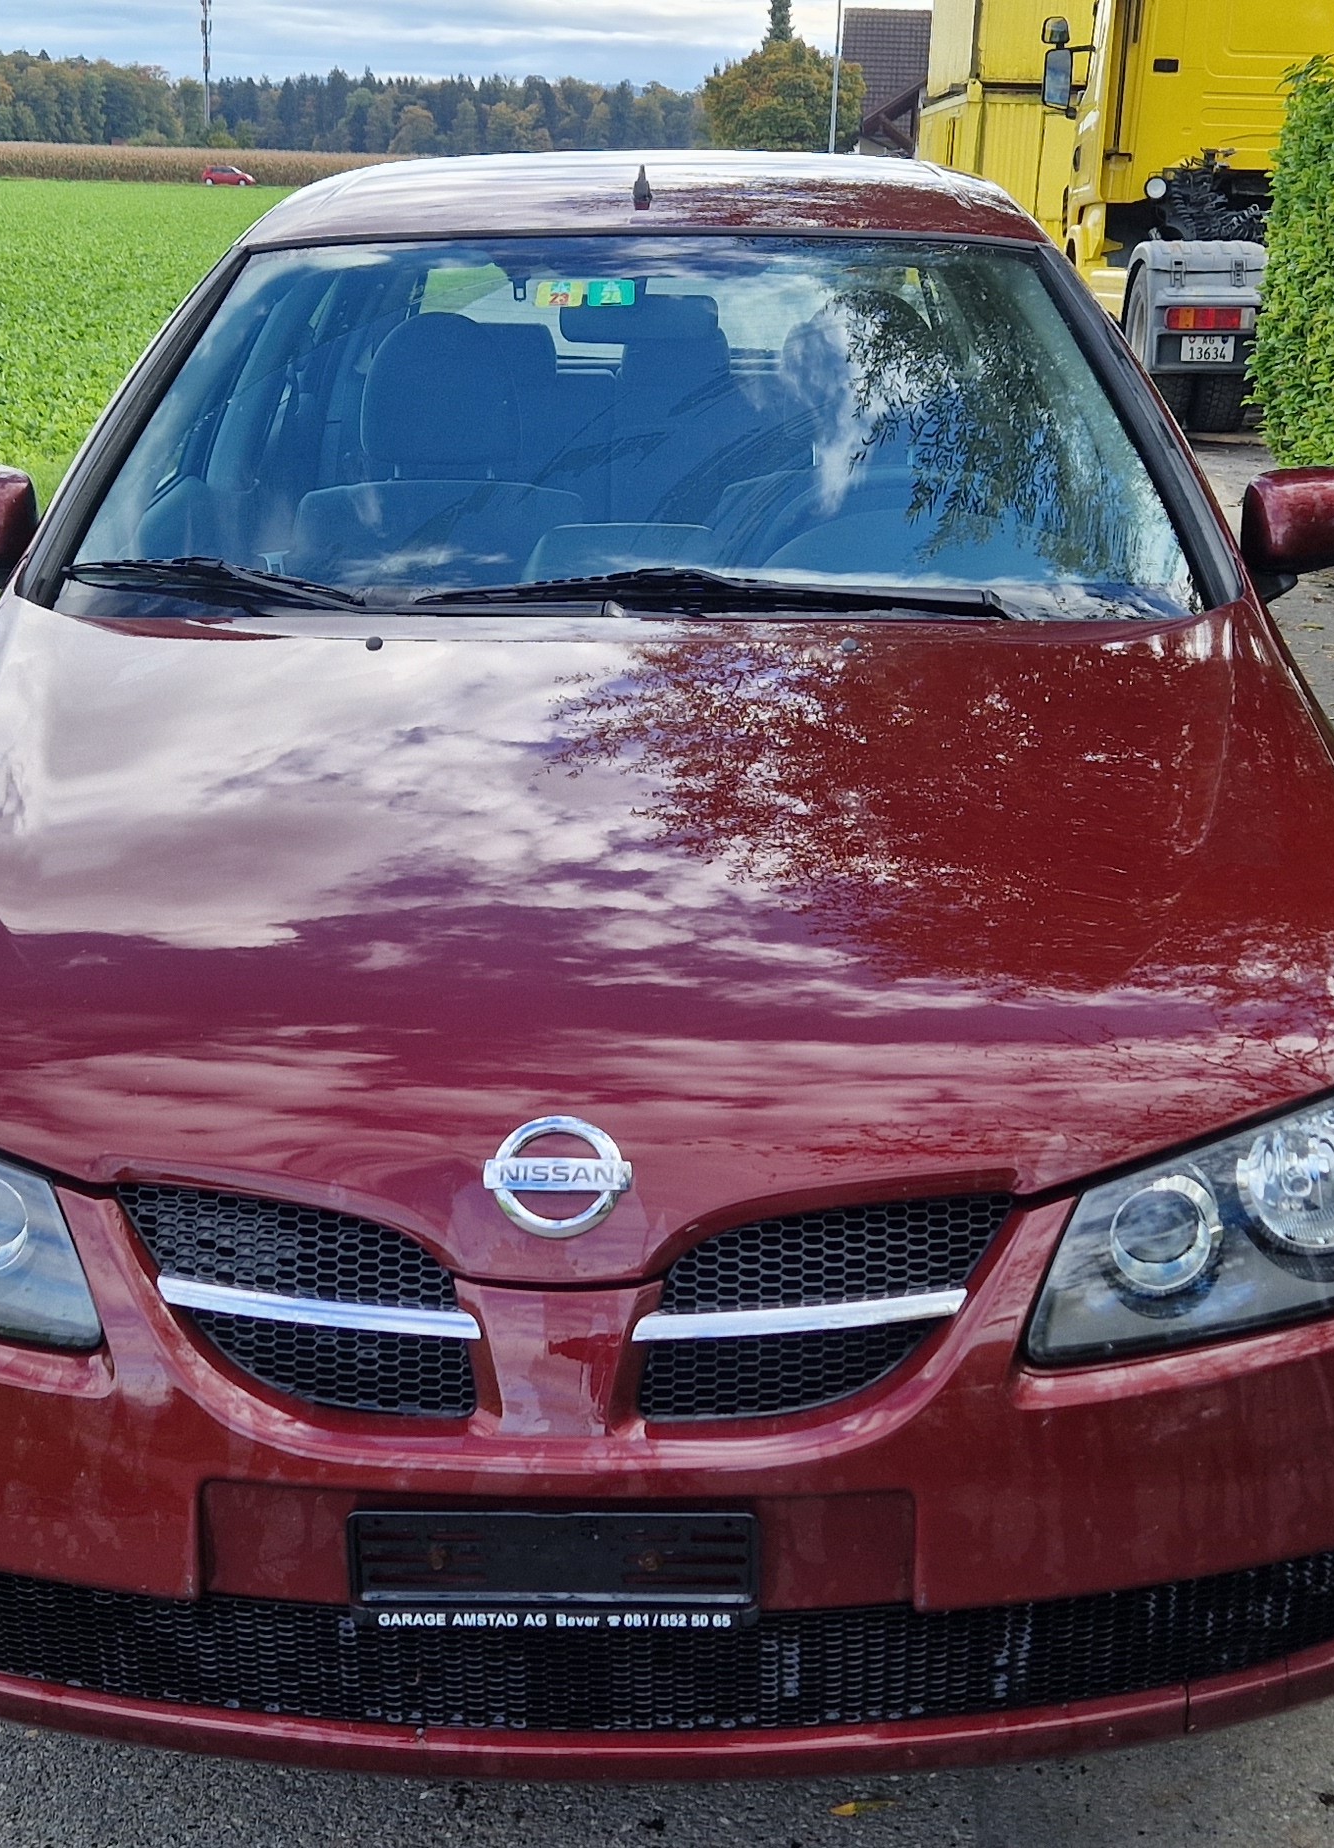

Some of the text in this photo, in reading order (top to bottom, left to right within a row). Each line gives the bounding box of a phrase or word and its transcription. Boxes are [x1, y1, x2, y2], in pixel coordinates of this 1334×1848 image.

[549, 292, 569, 304] 23
[602, 291, 621, 303] 24
[1202, 336, 1215, 345] AG
[1189, 347, 1226, 360] 13634
[499, 1166, 614, 1184] NISSAN
[378, 1613, 446, 1627] GARAGE
[452, 1613, 518, 1628] AMSTAD
[523, 1614, 547, 1627] AG
[556, 1614, 600, 1627] Bever
[691, 1614, 709, 1628] 50
[712, 1614, 732, 1628] 65
